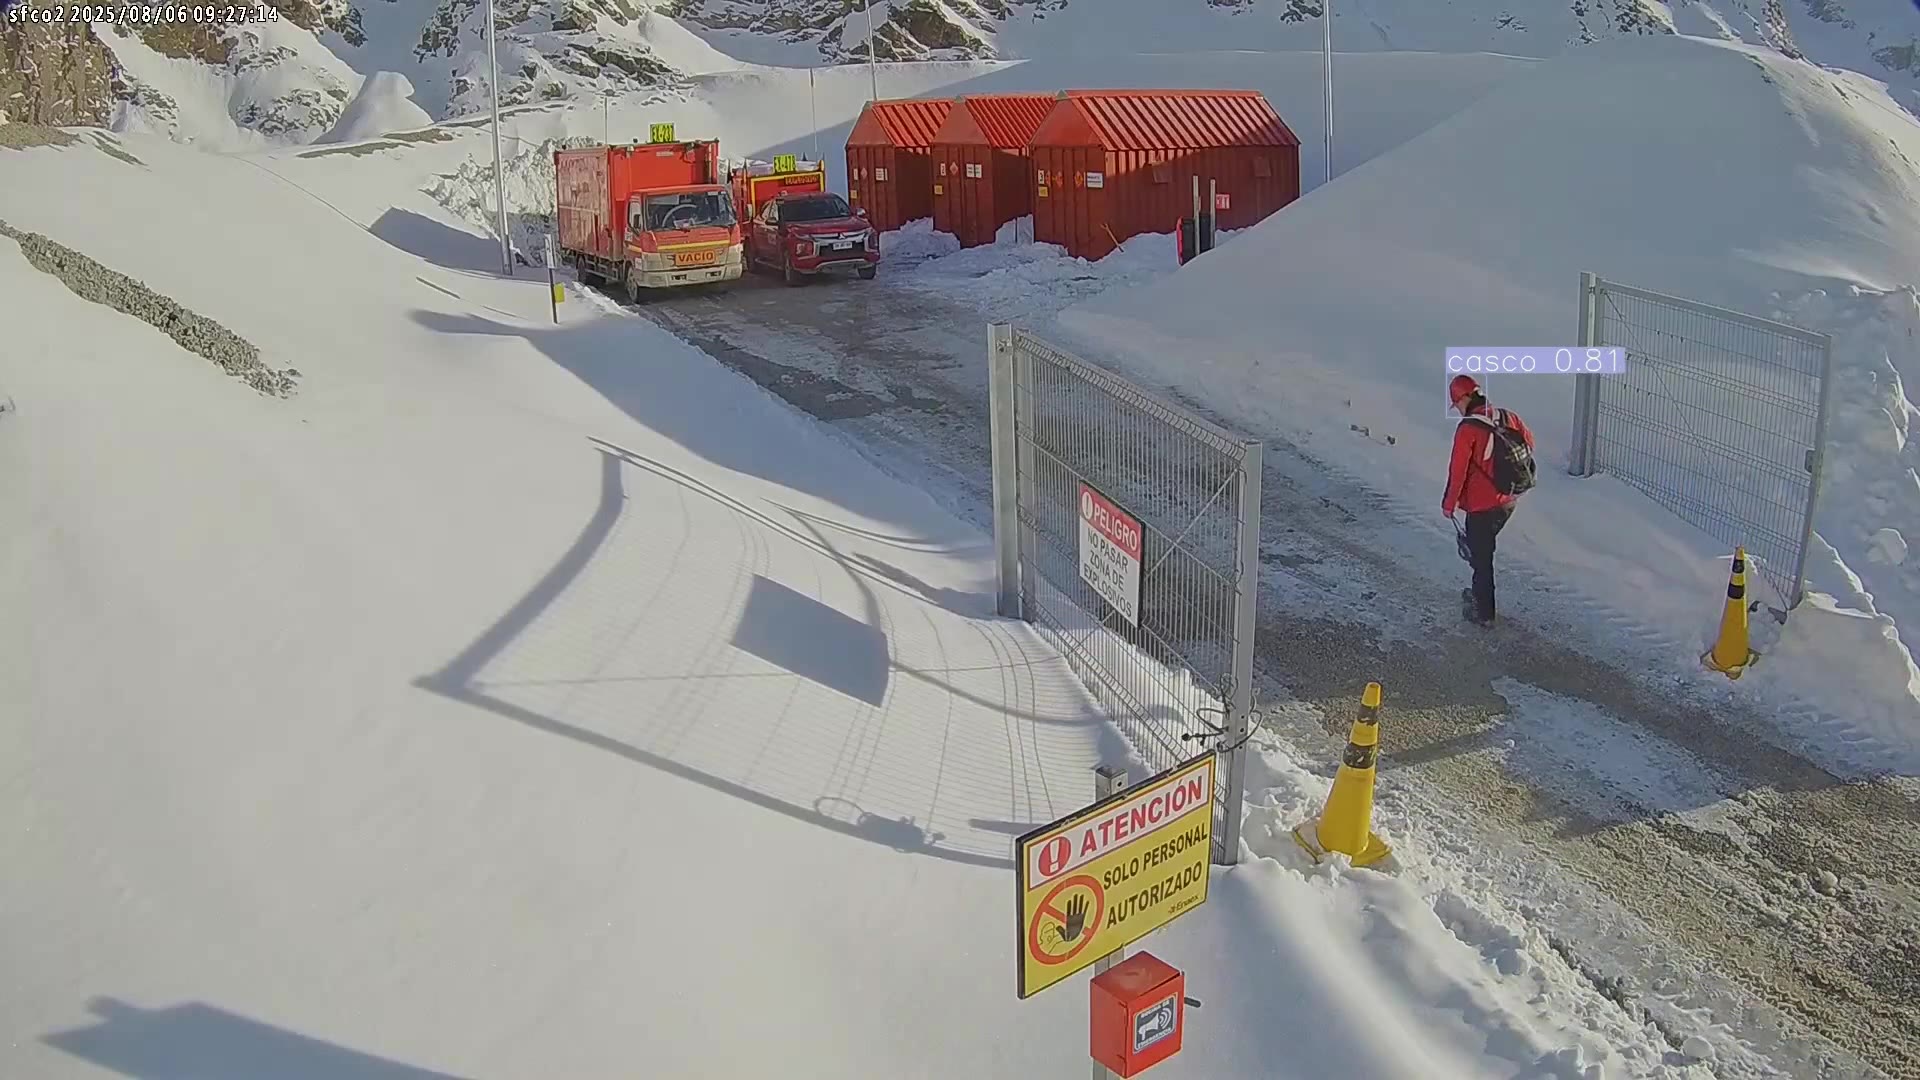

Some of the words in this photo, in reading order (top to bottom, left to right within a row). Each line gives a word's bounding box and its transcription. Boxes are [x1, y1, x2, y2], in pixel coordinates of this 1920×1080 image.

[678, 251, 714, 262] VACIO
[1087, 527, 1099, 549] NO
[1100, 536, 1129, 574] PASAR
[1093, 502, 1138, 552] PELIGRO
[1083, 564, 1132, 618] EXPLOSIVOS
[1089, 550, 1111, 582] ZONA
[1112, 569, 1124, 591] DE
[1080, 775, 1203, 857] ATENCIÓN
[1103, 857, 1140, 890] SOLO
[1143, 823, 1208, 872] PERSONAL
[1106, 860, 1203, 929] AUTORIZADO
